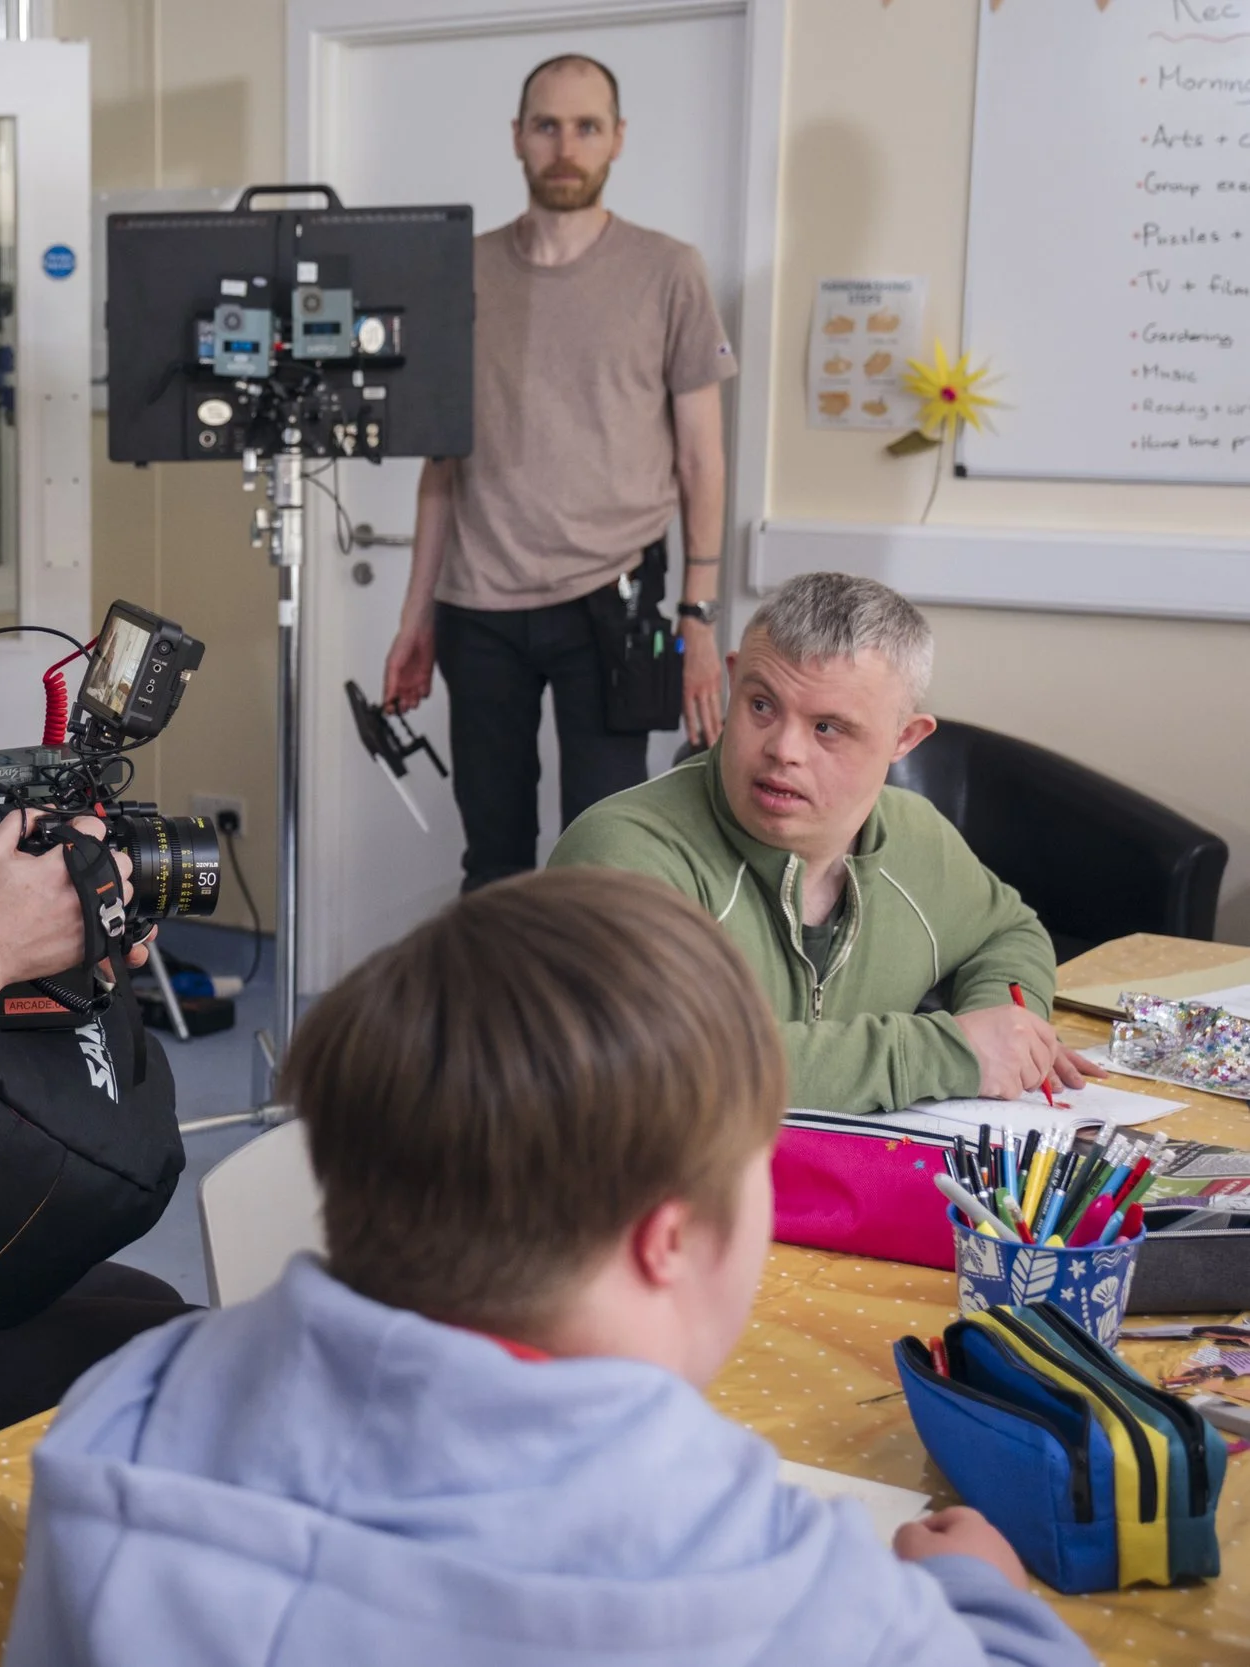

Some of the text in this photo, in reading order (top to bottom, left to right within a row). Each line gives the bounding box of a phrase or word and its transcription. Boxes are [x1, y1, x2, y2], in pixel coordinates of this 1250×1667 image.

[1151, 122, 1204, 149] Arts
[1144, 170, 1201, 199] Group
[1142, 321, 1234, 350] Gardening
[1142, 363, 1198, 384] Music
[197, 872, 217, 887] 50
